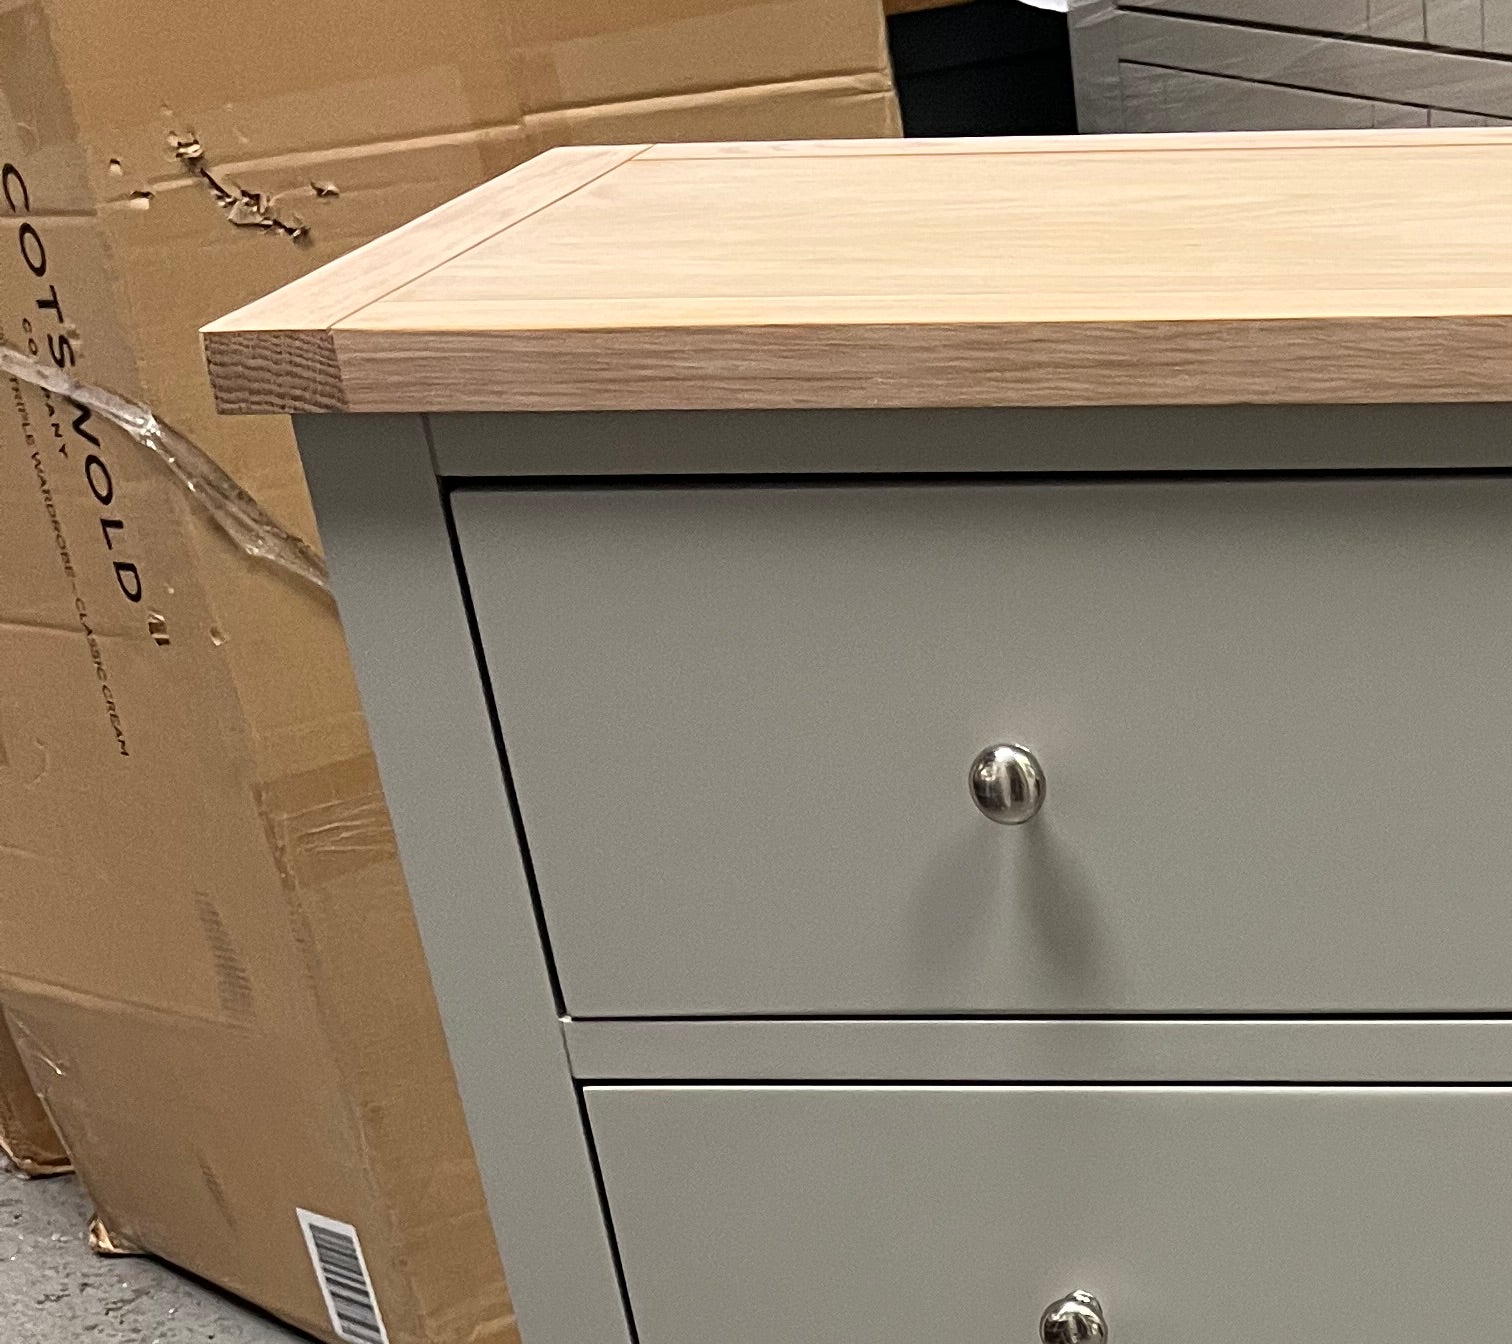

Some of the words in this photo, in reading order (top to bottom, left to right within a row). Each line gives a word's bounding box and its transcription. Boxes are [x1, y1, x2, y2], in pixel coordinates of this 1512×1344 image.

[22, 317, 69, 459] COPANY
[31, 451, 77, 579] WARDROBE
[75, 597, 108, 682] CLASSIC
[102, 684, 130, 757] CREAM
